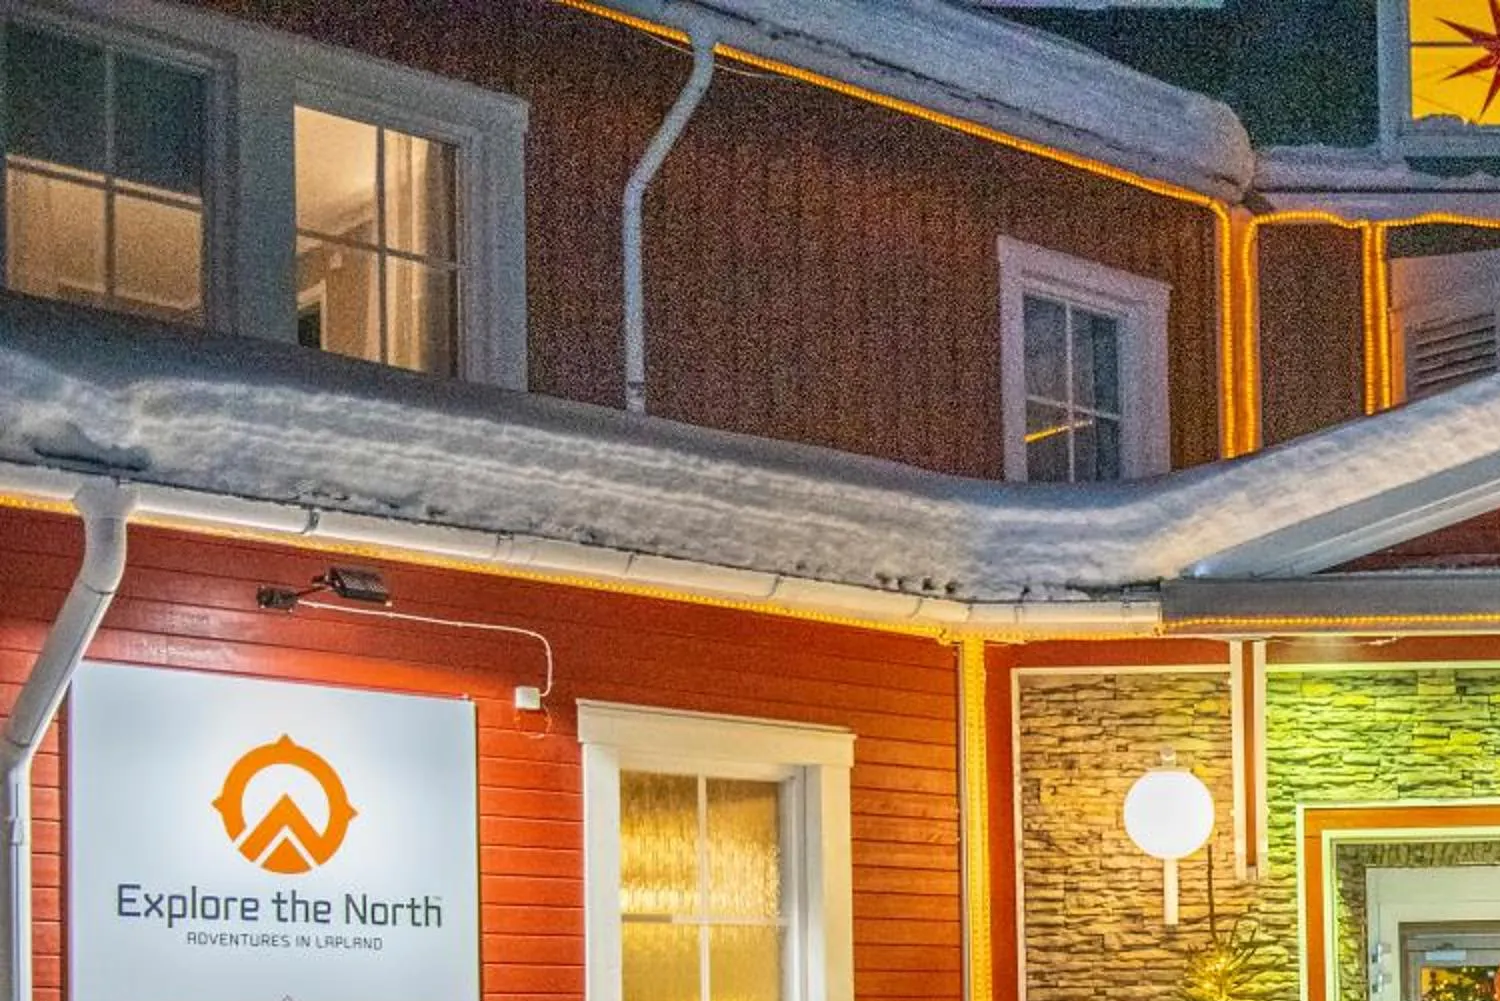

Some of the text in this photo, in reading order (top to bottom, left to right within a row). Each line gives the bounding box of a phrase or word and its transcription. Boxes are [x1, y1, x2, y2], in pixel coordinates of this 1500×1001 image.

[117, 883, 442, 928] Explore the North
[187, 931, 383, 951] ADVENTURES IN LAPLAND
